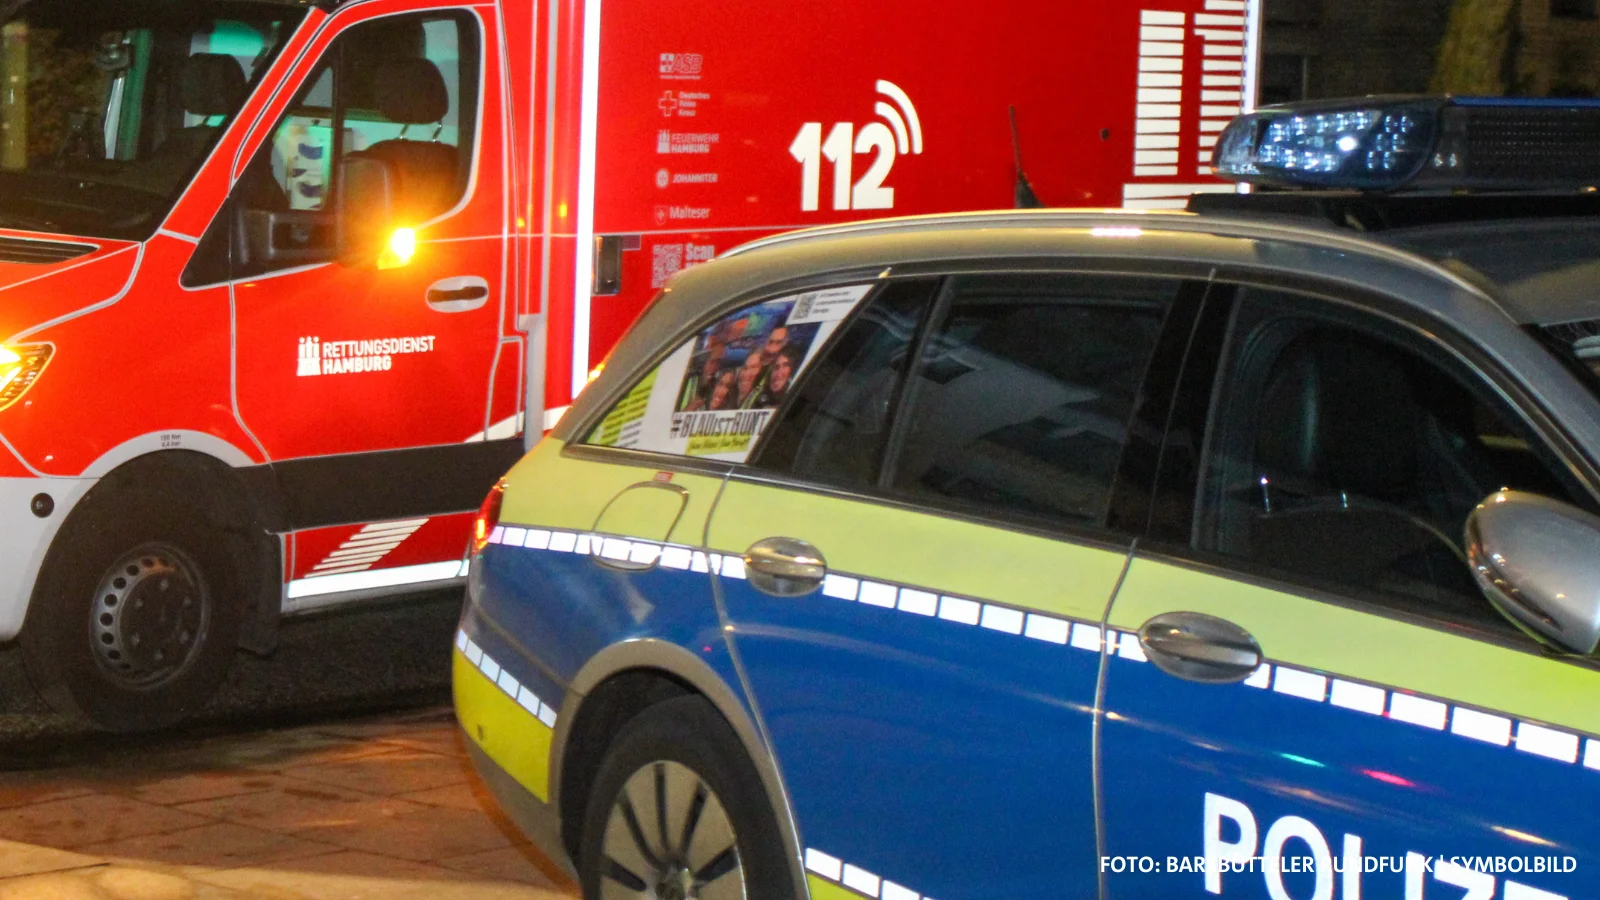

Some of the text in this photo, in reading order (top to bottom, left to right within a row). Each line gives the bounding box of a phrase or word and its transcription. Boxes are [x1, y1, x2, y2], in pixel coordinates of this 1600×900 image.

[671, 133, 719, 144] FEUERWEHR
[671, 144, 710, 153] HAMBURG
[788, 121, 896, 211] 112
[672, 173, 718, 184] JOHANNITER
[669, 205, 711, 218] Malteser
[685, 243, 715, 260] Scan
[322, 335, 436, 359] RETTUNGSDIENST
[322, 355, 392, 375] HAMBURG
[1203, 791, 1570, 900] POLIZ
